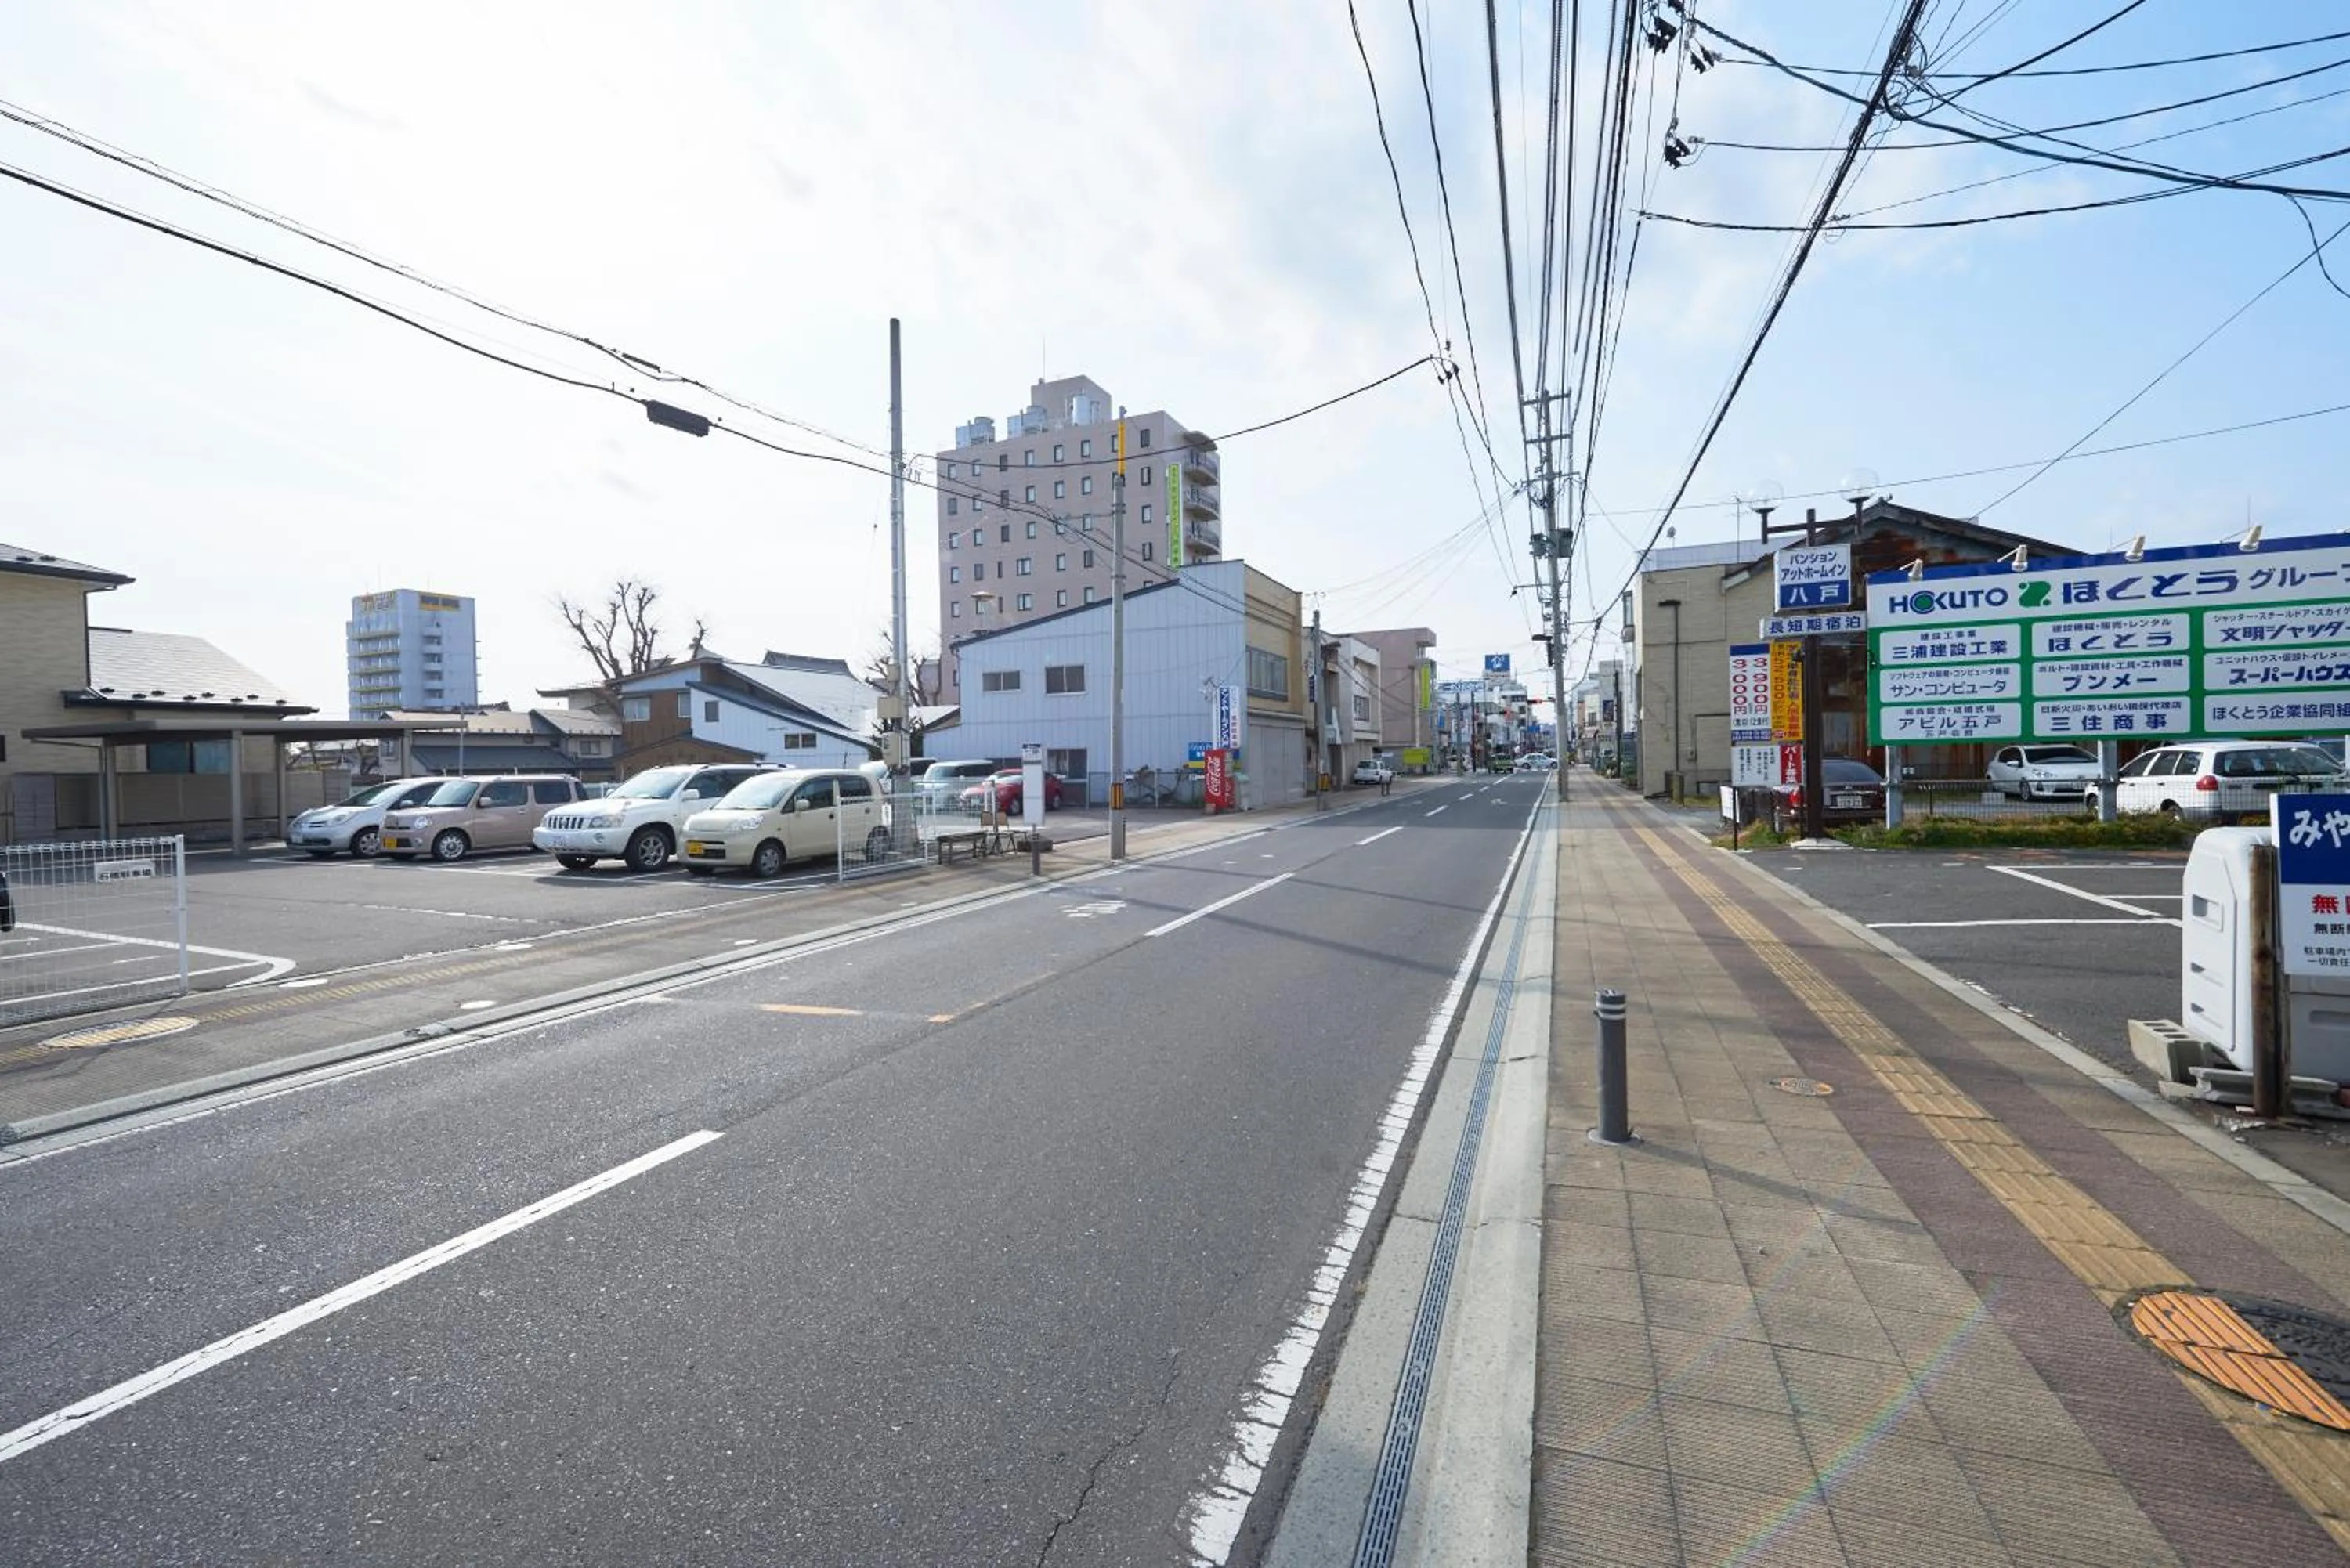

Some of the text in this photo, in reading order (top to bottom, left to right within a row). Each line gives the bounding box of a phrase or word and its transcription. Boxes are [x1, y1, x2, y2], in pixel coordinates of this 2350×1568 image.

[1781, 564, 1846, 582] アットホームイン
[1889, 587, 2008, 615] HOKUTO
[1769, 615, 1861, 634] 長短期宿泊
[2219, 621, 2350, 643] 文明シャッタ
[1892, 640, 2008, 659] 三浦建設工業
[2048, 631, 2173, 652] ほくとう
[1890, 680, 2007, 698] サン・コンピュータ
[2063, 673, 2157, 692] ブンメー
[1898, 714, 2001, 731] アビル五戸
[2050, 714, 2167, 731] 三住商事
[2312, 894, 2350, 915] 無
[2314, 923, 2350, 935] 無断
